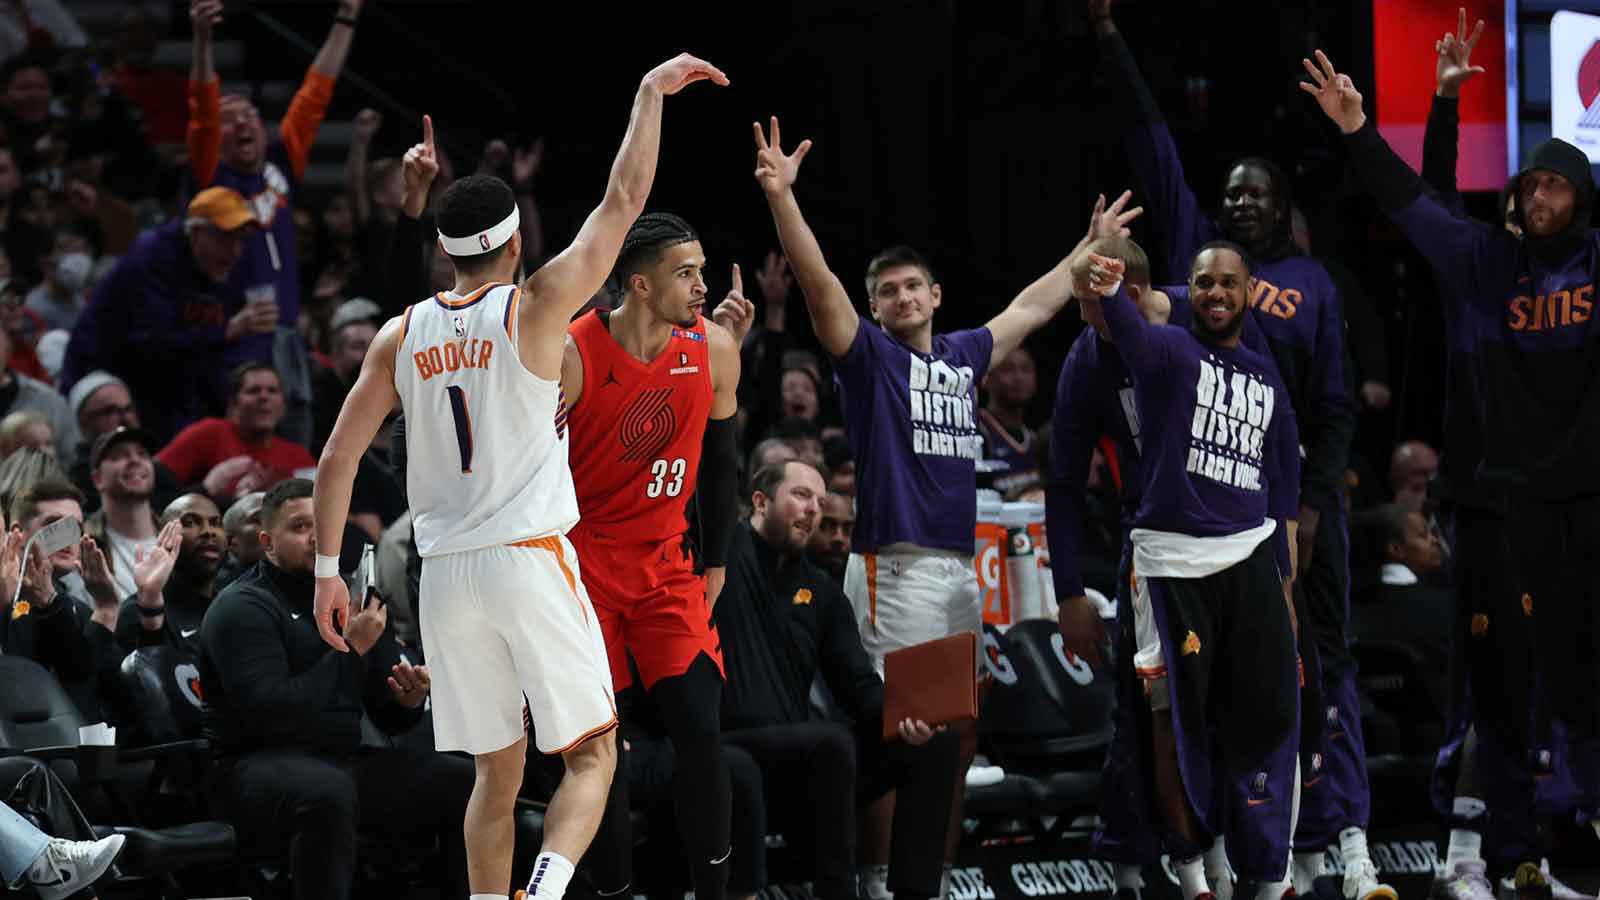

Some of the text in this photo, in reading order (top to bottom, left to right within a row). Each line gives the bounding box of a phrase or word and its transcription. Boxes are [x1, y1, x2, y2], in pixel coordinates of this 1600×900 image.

[1252, 279, 1303, 320] NS
[413, 338, 494, 381] BOOKER
[1196, 359, 1274, 432] BLACK
[446, 385, 473, 473] 1
[913, 428, 955, 456] BLACK
[646, 458, 686, 498] 33
[1186, 447, 1235, 485] BLACK
[1011, 859, 1118, 897] GATORA
